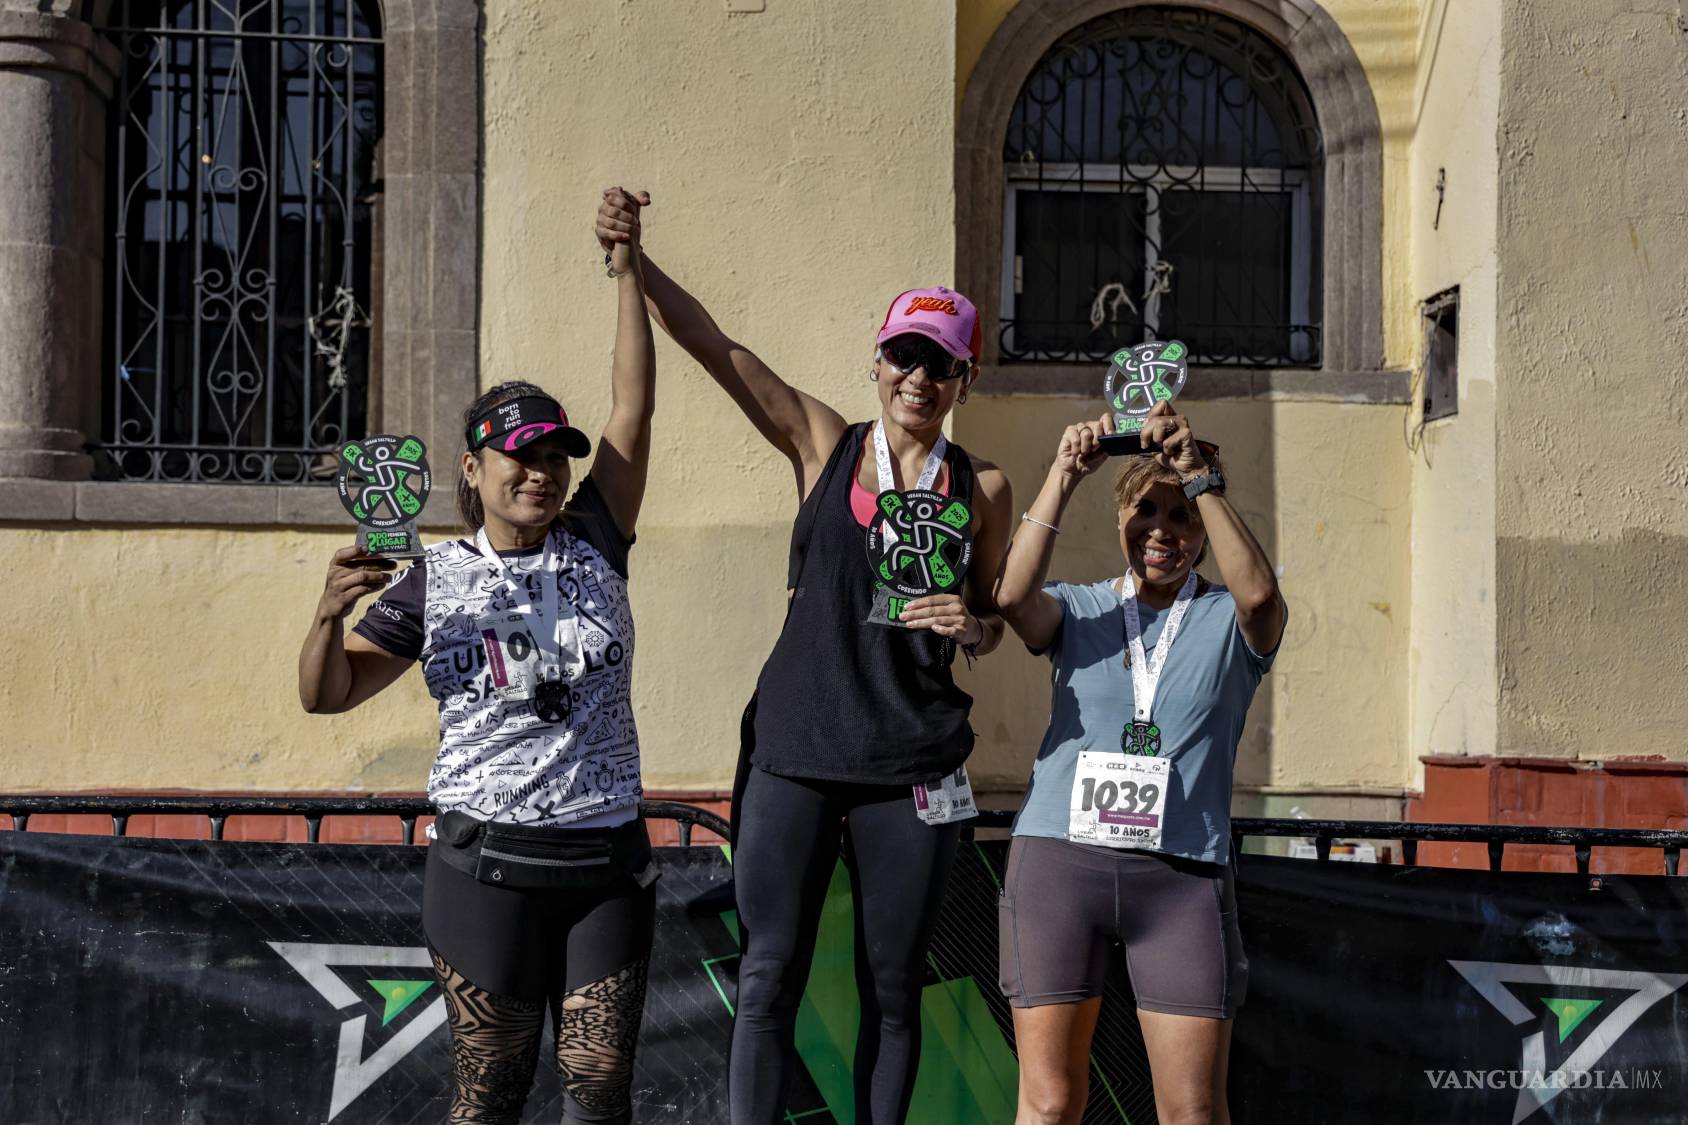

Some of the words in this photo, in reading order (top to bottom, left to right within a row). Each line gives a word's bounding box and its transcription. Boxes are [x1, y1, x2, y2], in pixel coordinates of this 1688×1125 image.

[904, 297, 958, 315] yeah
[498, 403, 519, 415] born
[509, 408, 520, 416] to
[506, 413, 521, 423] run
[504, 419, 522, 431] free
[376, 537, 407, 546] LUGAR
[897, 584, 927, 595] CORRIENDO
[494, 773, 550, 808] RUNNING
[1081, 777, 1160, 814] 1039
[1110, 825, 1120, 835] 10
[1122, 825, 1150, 838] AÑOS
